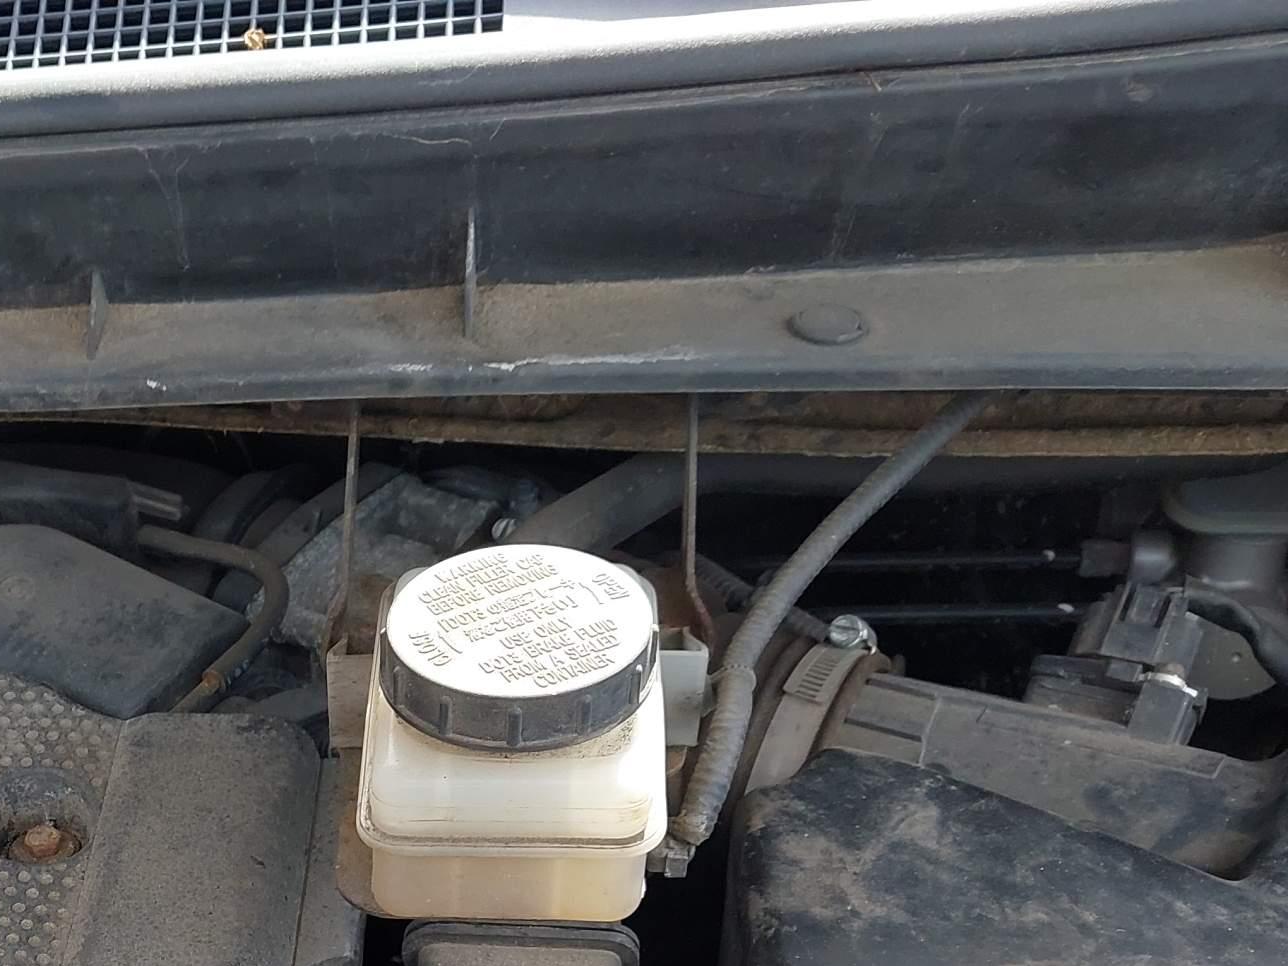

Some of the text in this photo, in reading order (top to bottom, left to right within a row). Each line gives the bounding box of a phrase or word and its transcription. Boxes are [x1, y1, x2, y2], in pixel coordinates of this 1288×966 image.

[418, 580, 462, 604] CLEAN
[468, 563, 516, 590] FILLER
[517, 553, 545, 570] CAP
[434, 553, 508, 583] WARNING
[427, 586, 485, 616] BEFORE
[487, 564, 559, 596] REMOVING
[592, 573, 630, 601] OPEN
[409, 631, 453, 667] CLOSE
[499, 632, 530, 650] USE
[537, 617, 573, 640] ONLY
[525, 633, 572, 664] BRAKE
[576, 618, 618, 643] FLUID
[500, 634, 620, 684] FROM A SEALED
[533, 653, 615, 688] CONTAINER
